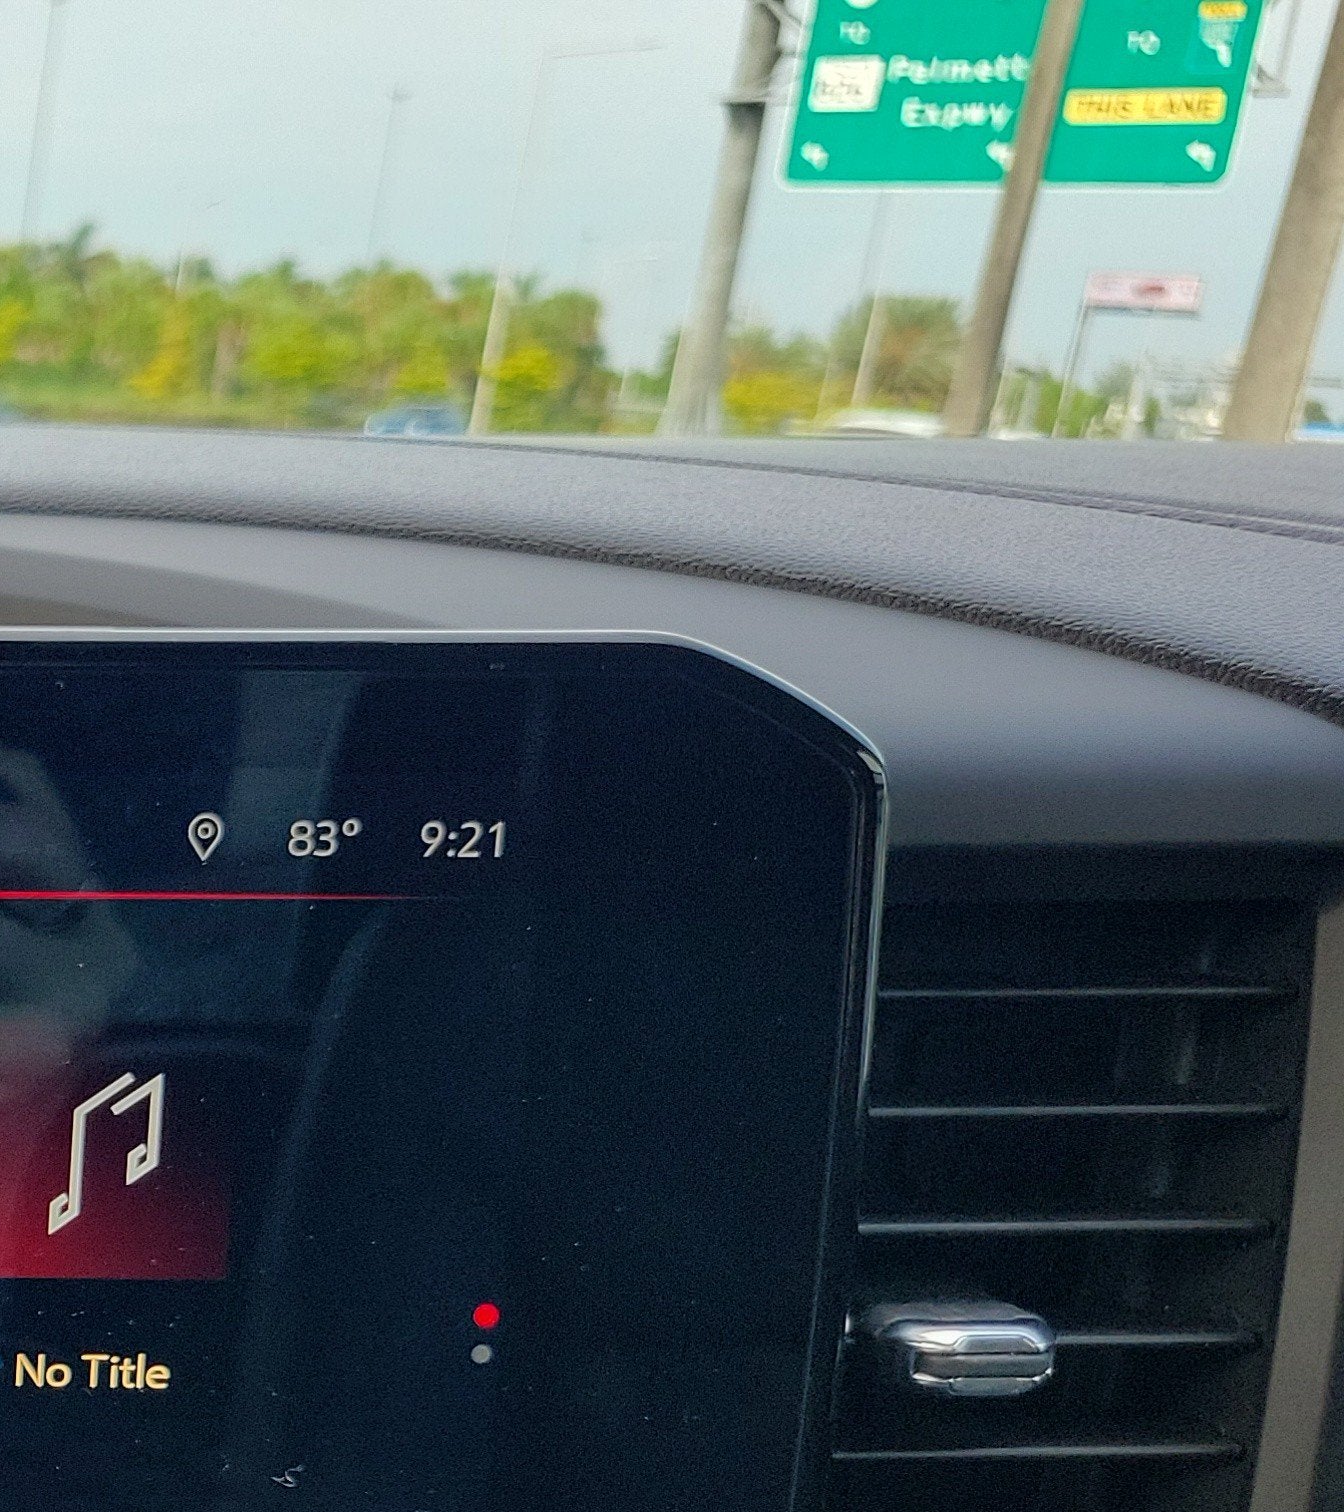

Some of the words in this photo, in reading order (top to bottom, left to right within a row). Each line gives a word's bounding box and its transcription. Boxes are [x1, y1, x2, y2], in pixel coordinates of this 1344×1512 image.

[887, 53, 1030, 84] Palmett
[419, 820, 507, 859] 9:21
[15, 1353, 72, 1388] No
[81, 1352, 171, 1390] Title
